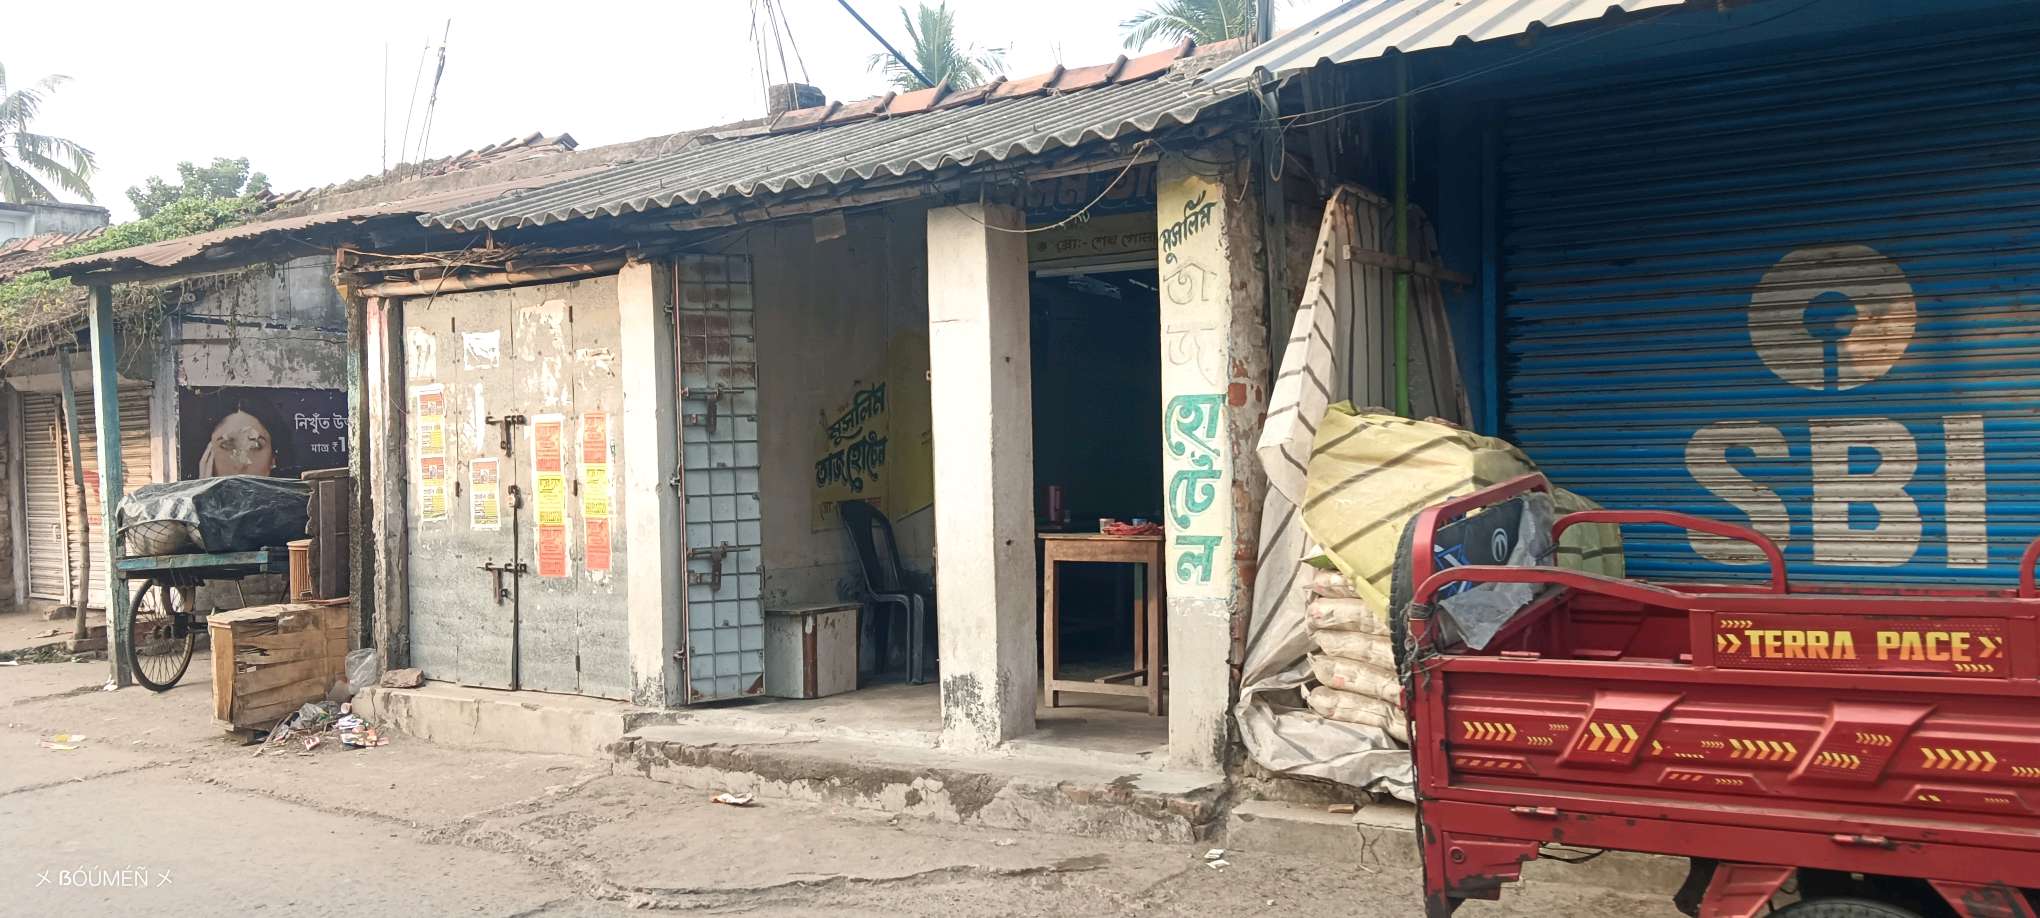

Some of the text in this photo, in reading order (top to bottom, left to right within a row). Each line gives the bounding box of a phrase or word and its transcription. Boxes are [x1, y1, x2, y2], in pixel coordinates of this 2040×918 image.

[294, 412, 331, 435] নিখুঁত
[827, 382, 886, 446] মুসলিম
[311, 443, 330, 453] মাত্র
[1165, 393, 1227, 584] হোটেল
[1685, 414, 1989, 569] SBI
[1744, 629, 1972, 662] TERRA PACE
